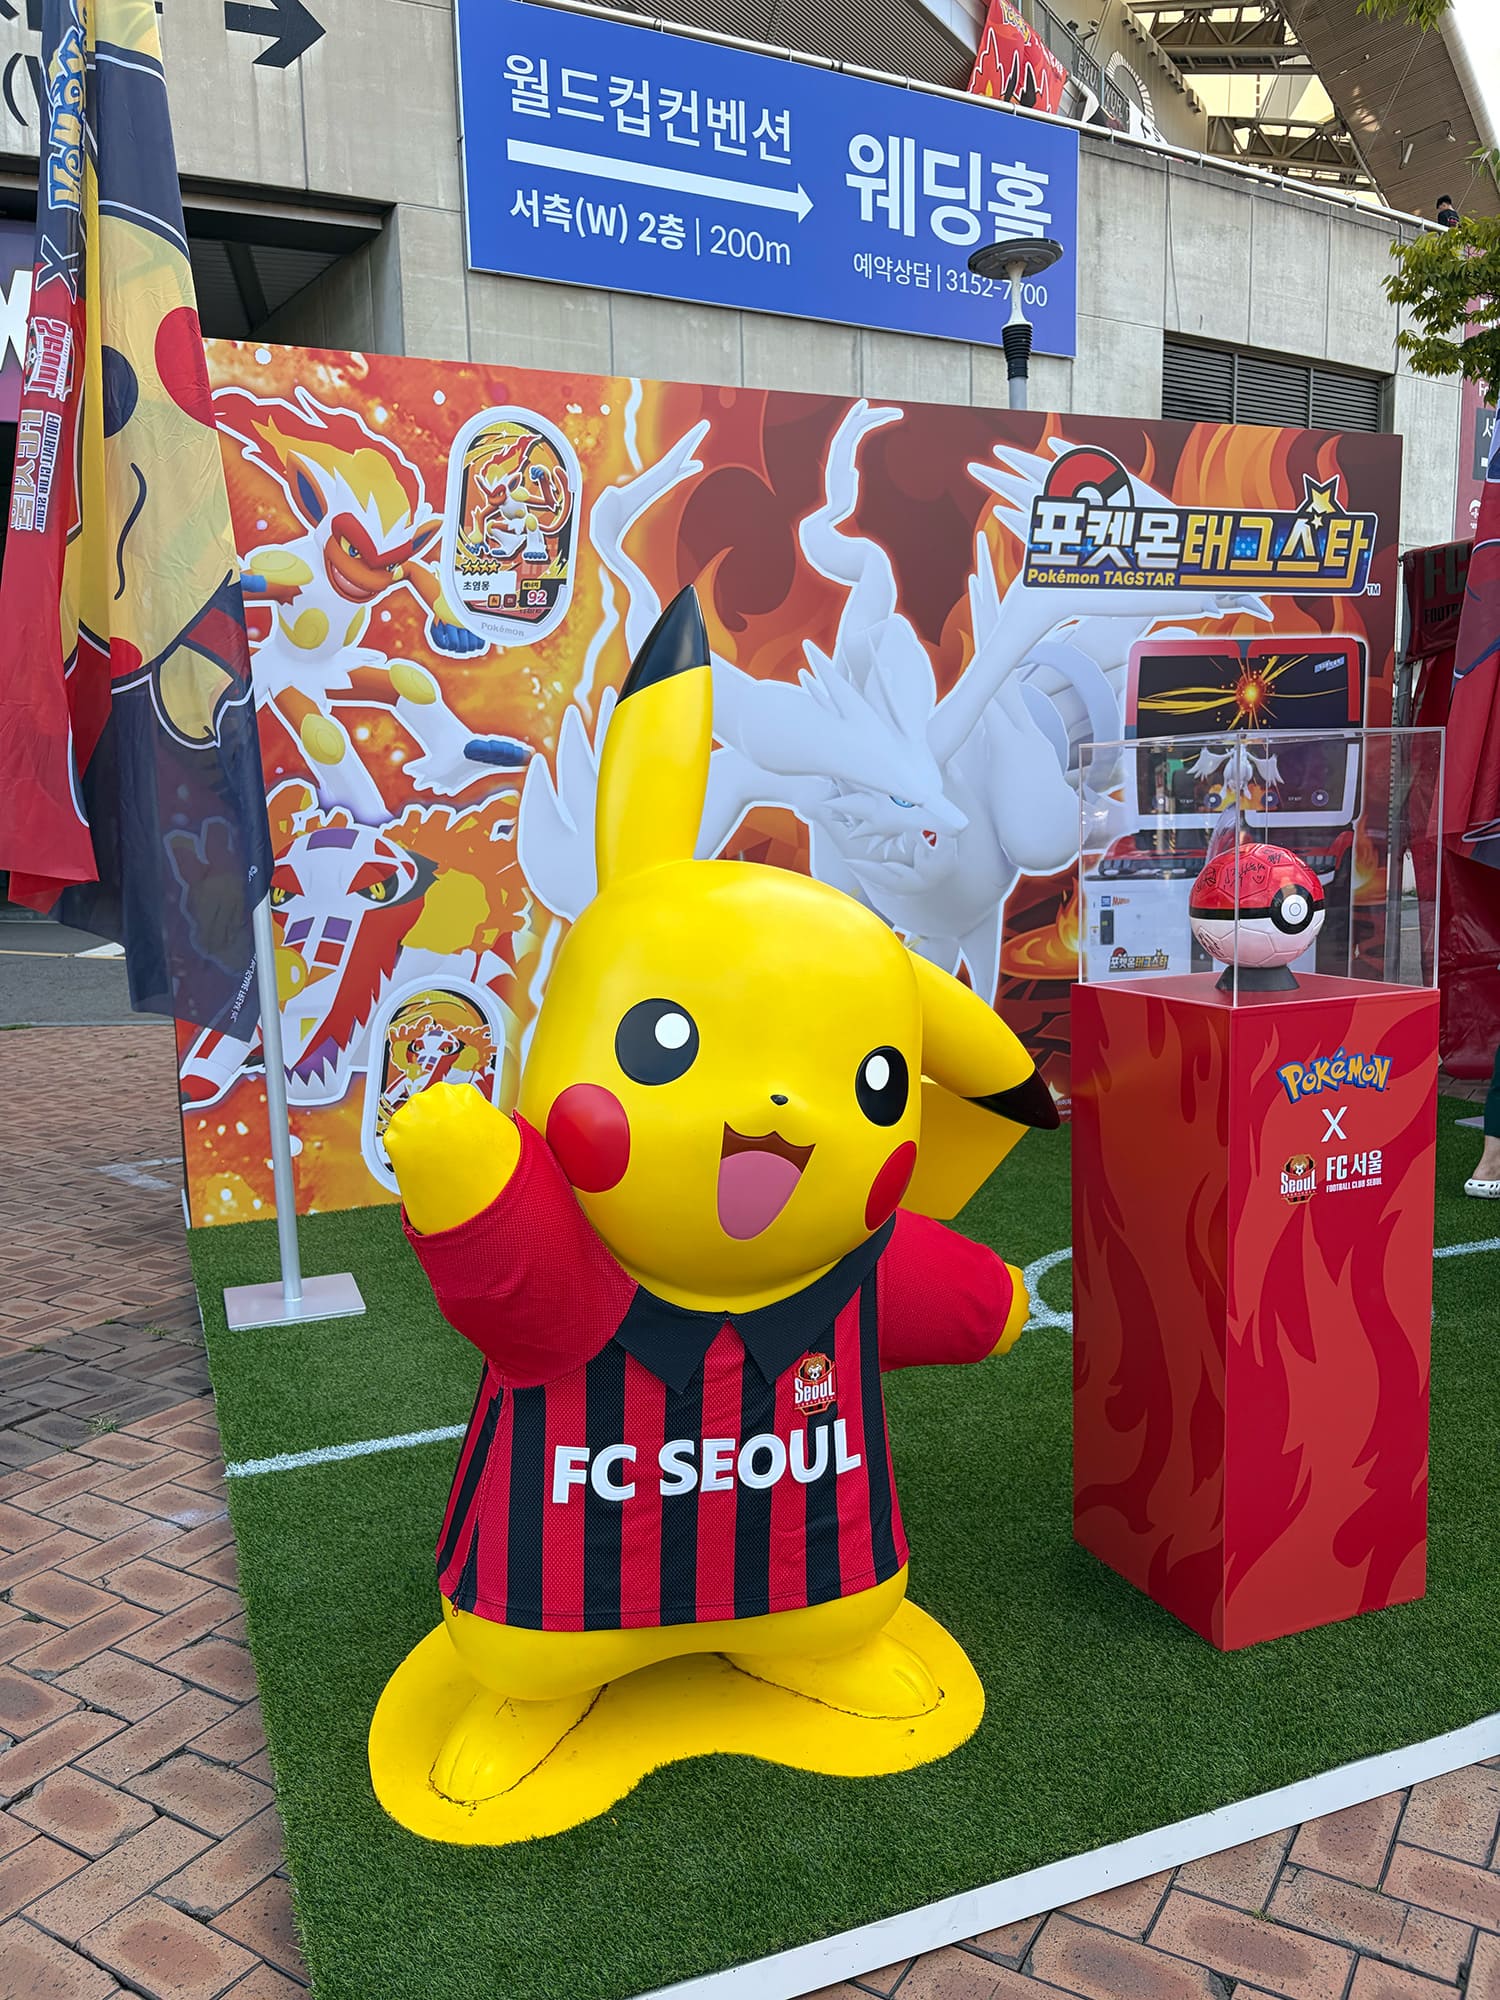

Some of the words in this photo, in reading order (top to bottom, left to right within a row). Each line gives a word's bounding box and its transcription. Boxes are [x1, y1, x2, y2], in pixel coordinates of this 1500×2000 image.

[503, 54, 792, 165] 월드컵컨벤션
[845, 133, 1052, 247] 웨딩홀
[510, 189, 629, 245] 서측(W)
[637, 211, 686, 250] 2층
[709, 224, 791, 266] 200m
[853, 252, 932, 289] 예약상담
[1027, 569, 1099, 586] Pokémon
[1103, 571, 1175, 587] TAGSTAR
[1424, 544, 1468, 600] FC
[527, 590, 547, 606] 92
[480, 621, 525, 638] Pokémon
[1321, 1106, 1348, 1143] X
[1326, 1181, 1351, 1193] FOOTBALL
[1352, 1179, 1366, 1189] CLUB
[1366, 1177, 1382, 1187] SEOUL
[794, 1371, 835, 1404] Seoul
[552, 1443, 636, 1504] FC
[658, 1418, 861, 1496] SEOUL
